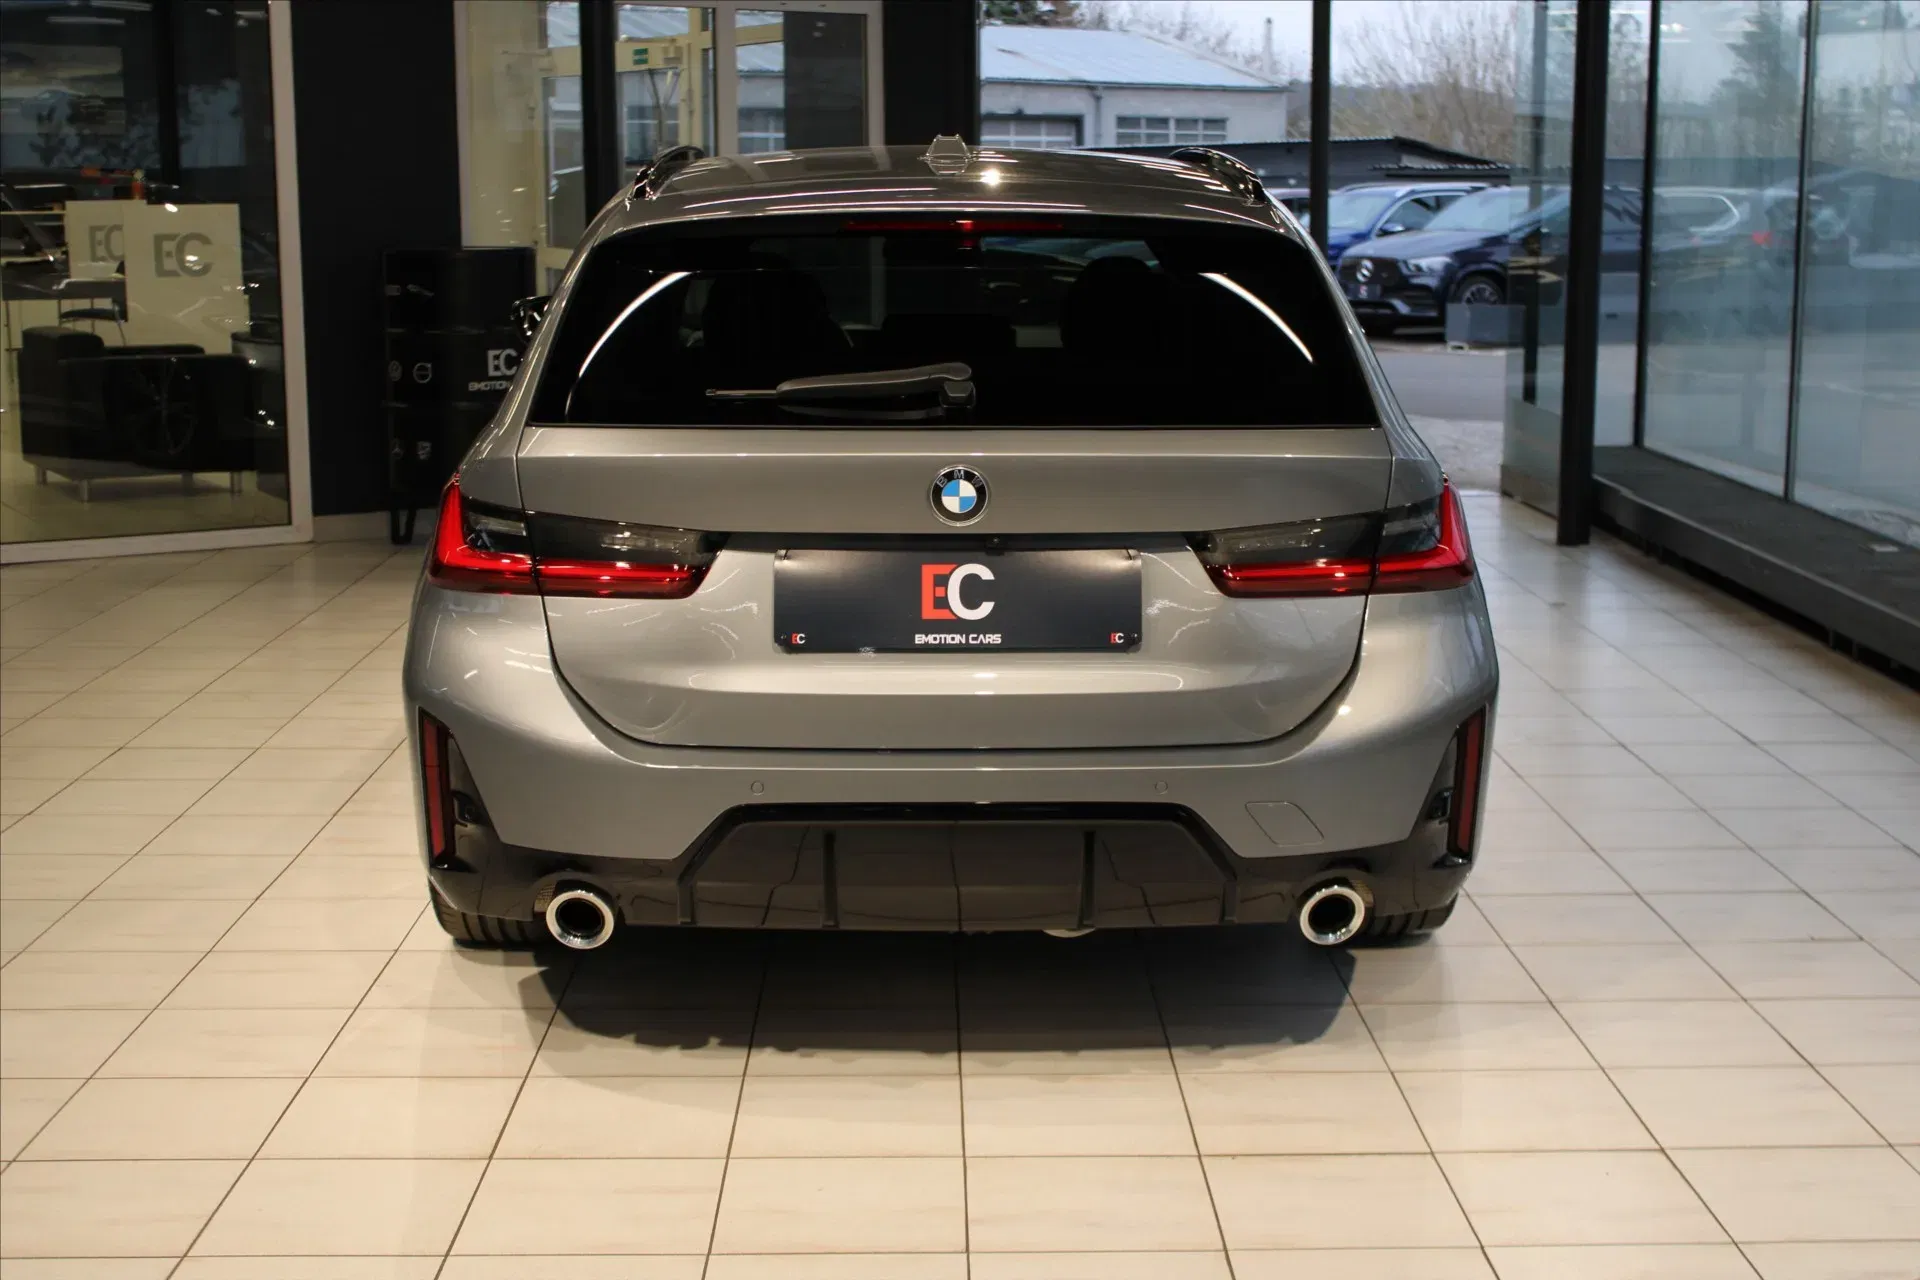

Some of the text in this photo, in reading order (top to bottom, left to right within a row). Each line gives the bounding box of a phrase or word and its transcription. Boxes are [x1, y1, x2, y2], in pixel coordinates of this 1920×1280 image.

[154, 232, 214, 277] EC
[487, 348, 518, 377] EC
[936, 469, 983, 488] BMW
[921, 563, 995, 620] EC
[791, 633, 806, 644] EC
[915, 634, 1002, 644] EMOTION CARS
[1110, 632, 1124, 644] EC
